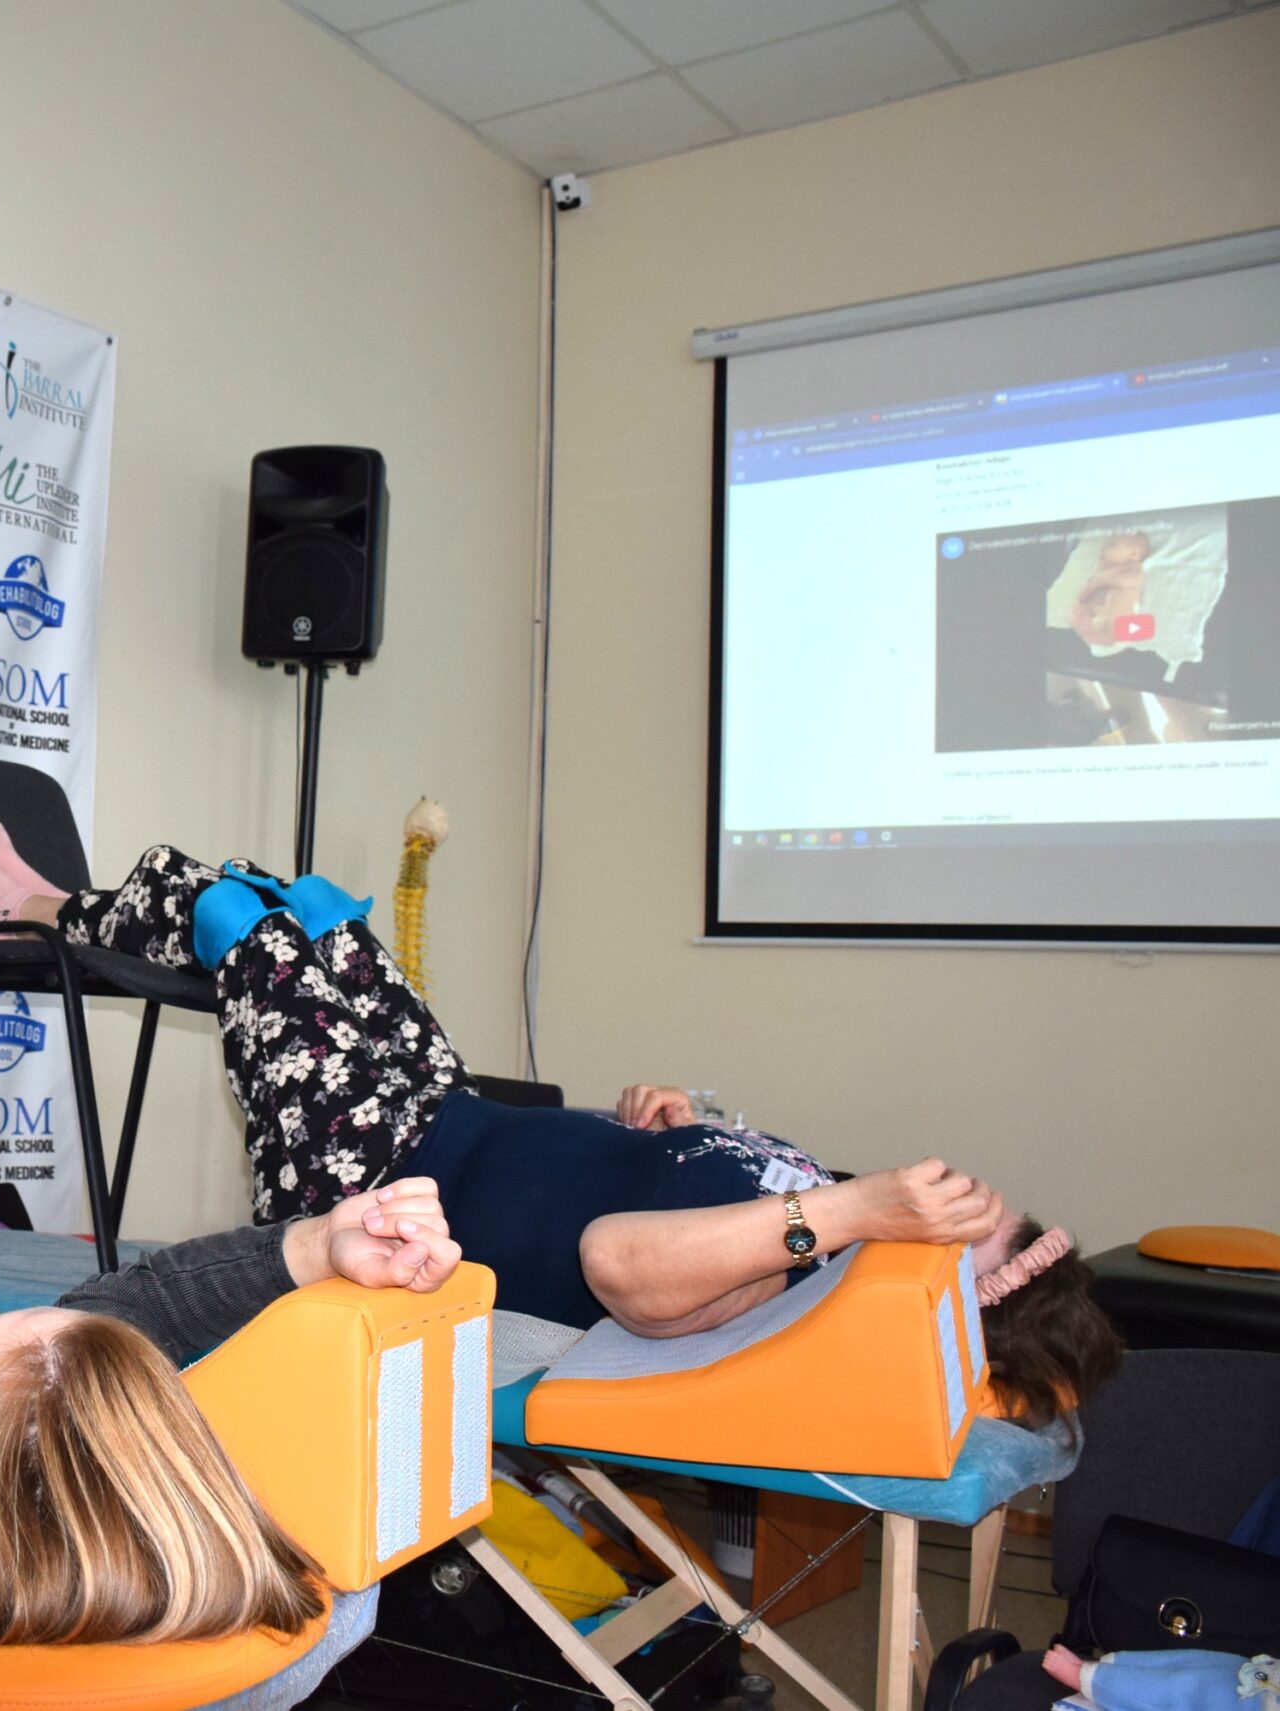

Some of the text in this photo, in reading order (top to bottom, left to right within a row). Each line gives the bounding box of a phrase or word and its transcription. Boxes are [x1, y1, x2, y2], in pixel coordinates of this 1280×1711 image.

[36, 463, 58, 480] THE
[36, 495, 79, 522] INSTE
[30, 710, 70, 727] SCHOOL
[20, 734, 70, 753] MEDICINE
[15, 1140, 55, 1153] SCHOOL
[5, 1166, 55, 1180] MEDICINE
